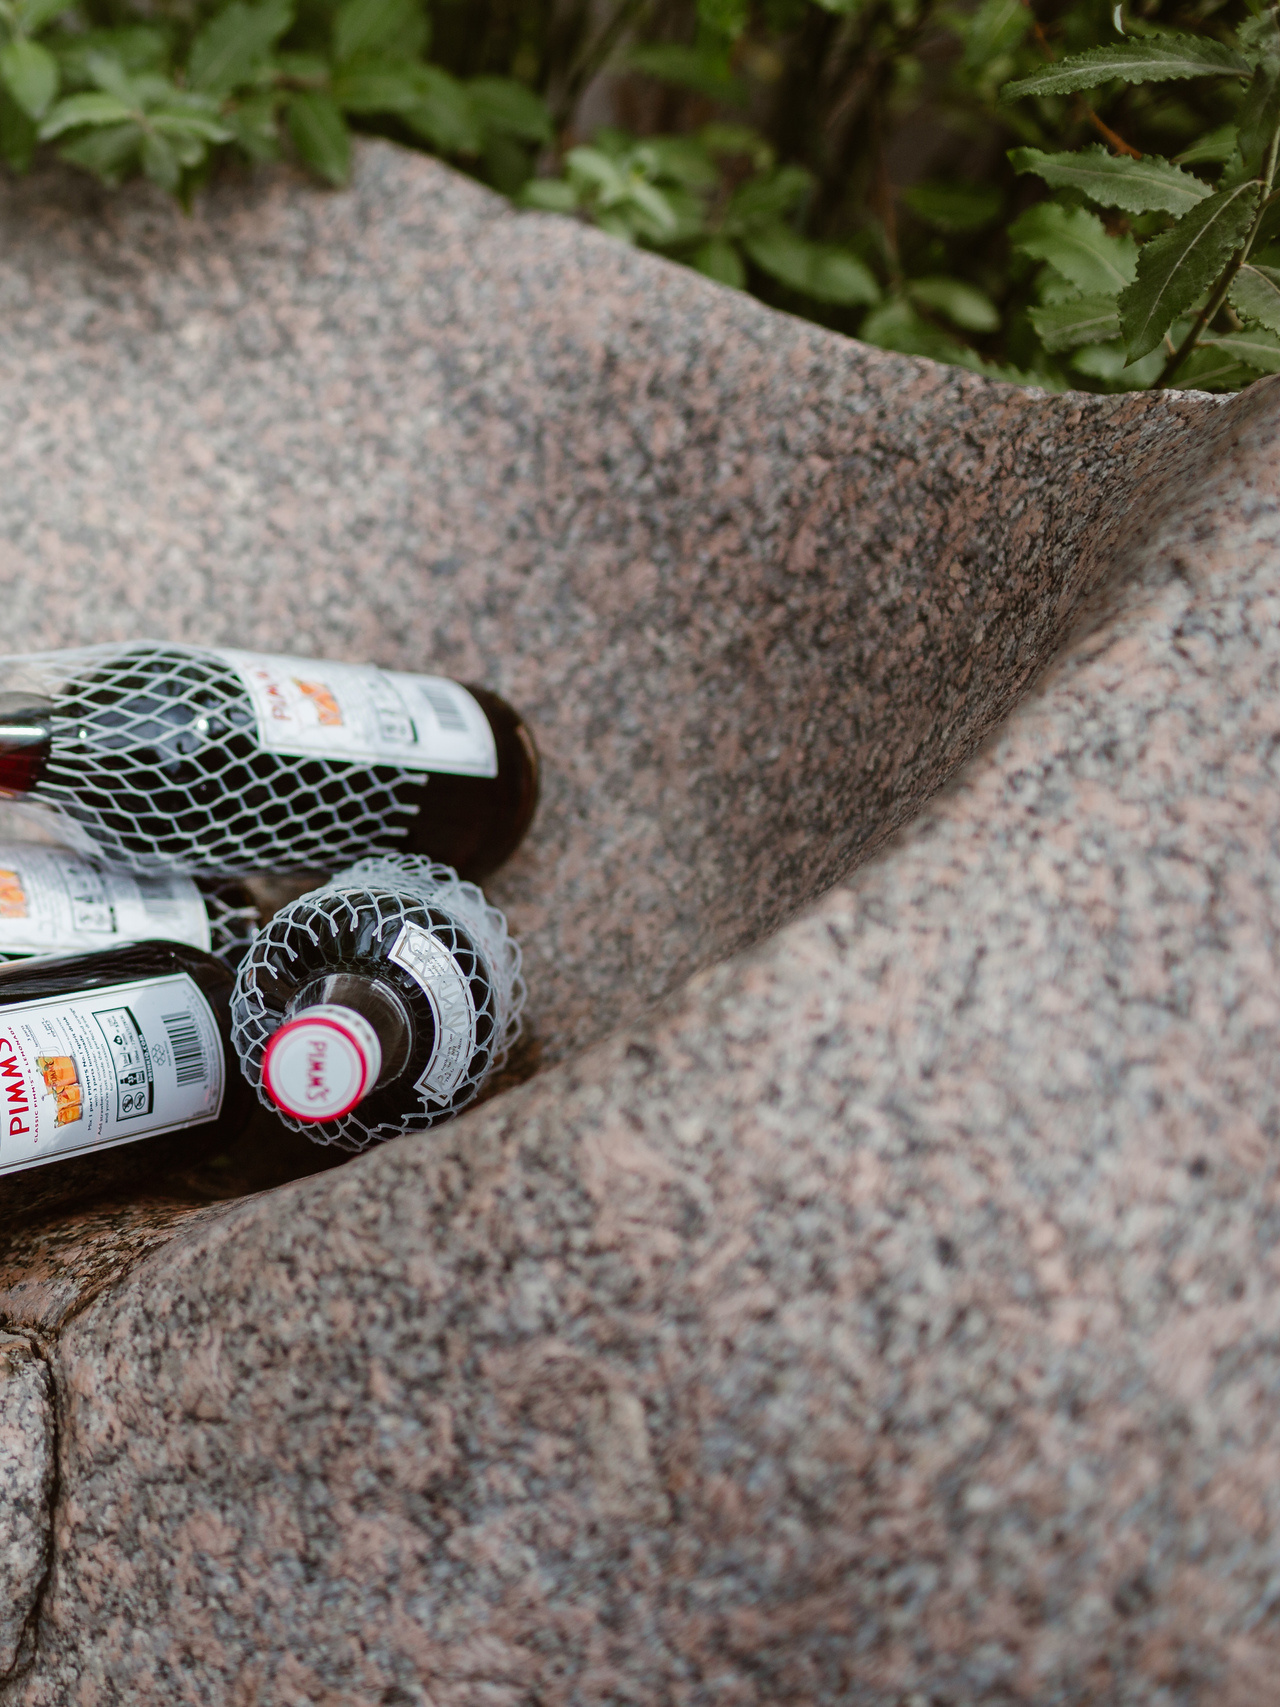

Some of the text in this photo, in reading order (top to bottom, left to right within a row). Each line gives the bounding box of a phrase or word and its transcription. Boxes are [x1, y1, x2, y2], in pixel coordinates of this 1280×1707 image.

[62, 1016, 74, 1032] drink
[79, 1024, 87, 1035] and
[7, 1025, 29, 1065] LEMONADE
[71, 1032, 82, 1049] spirit
[78, 1034, 92, 1067] lemonade
[307, 1040, 329, 1101] PIMM'S
